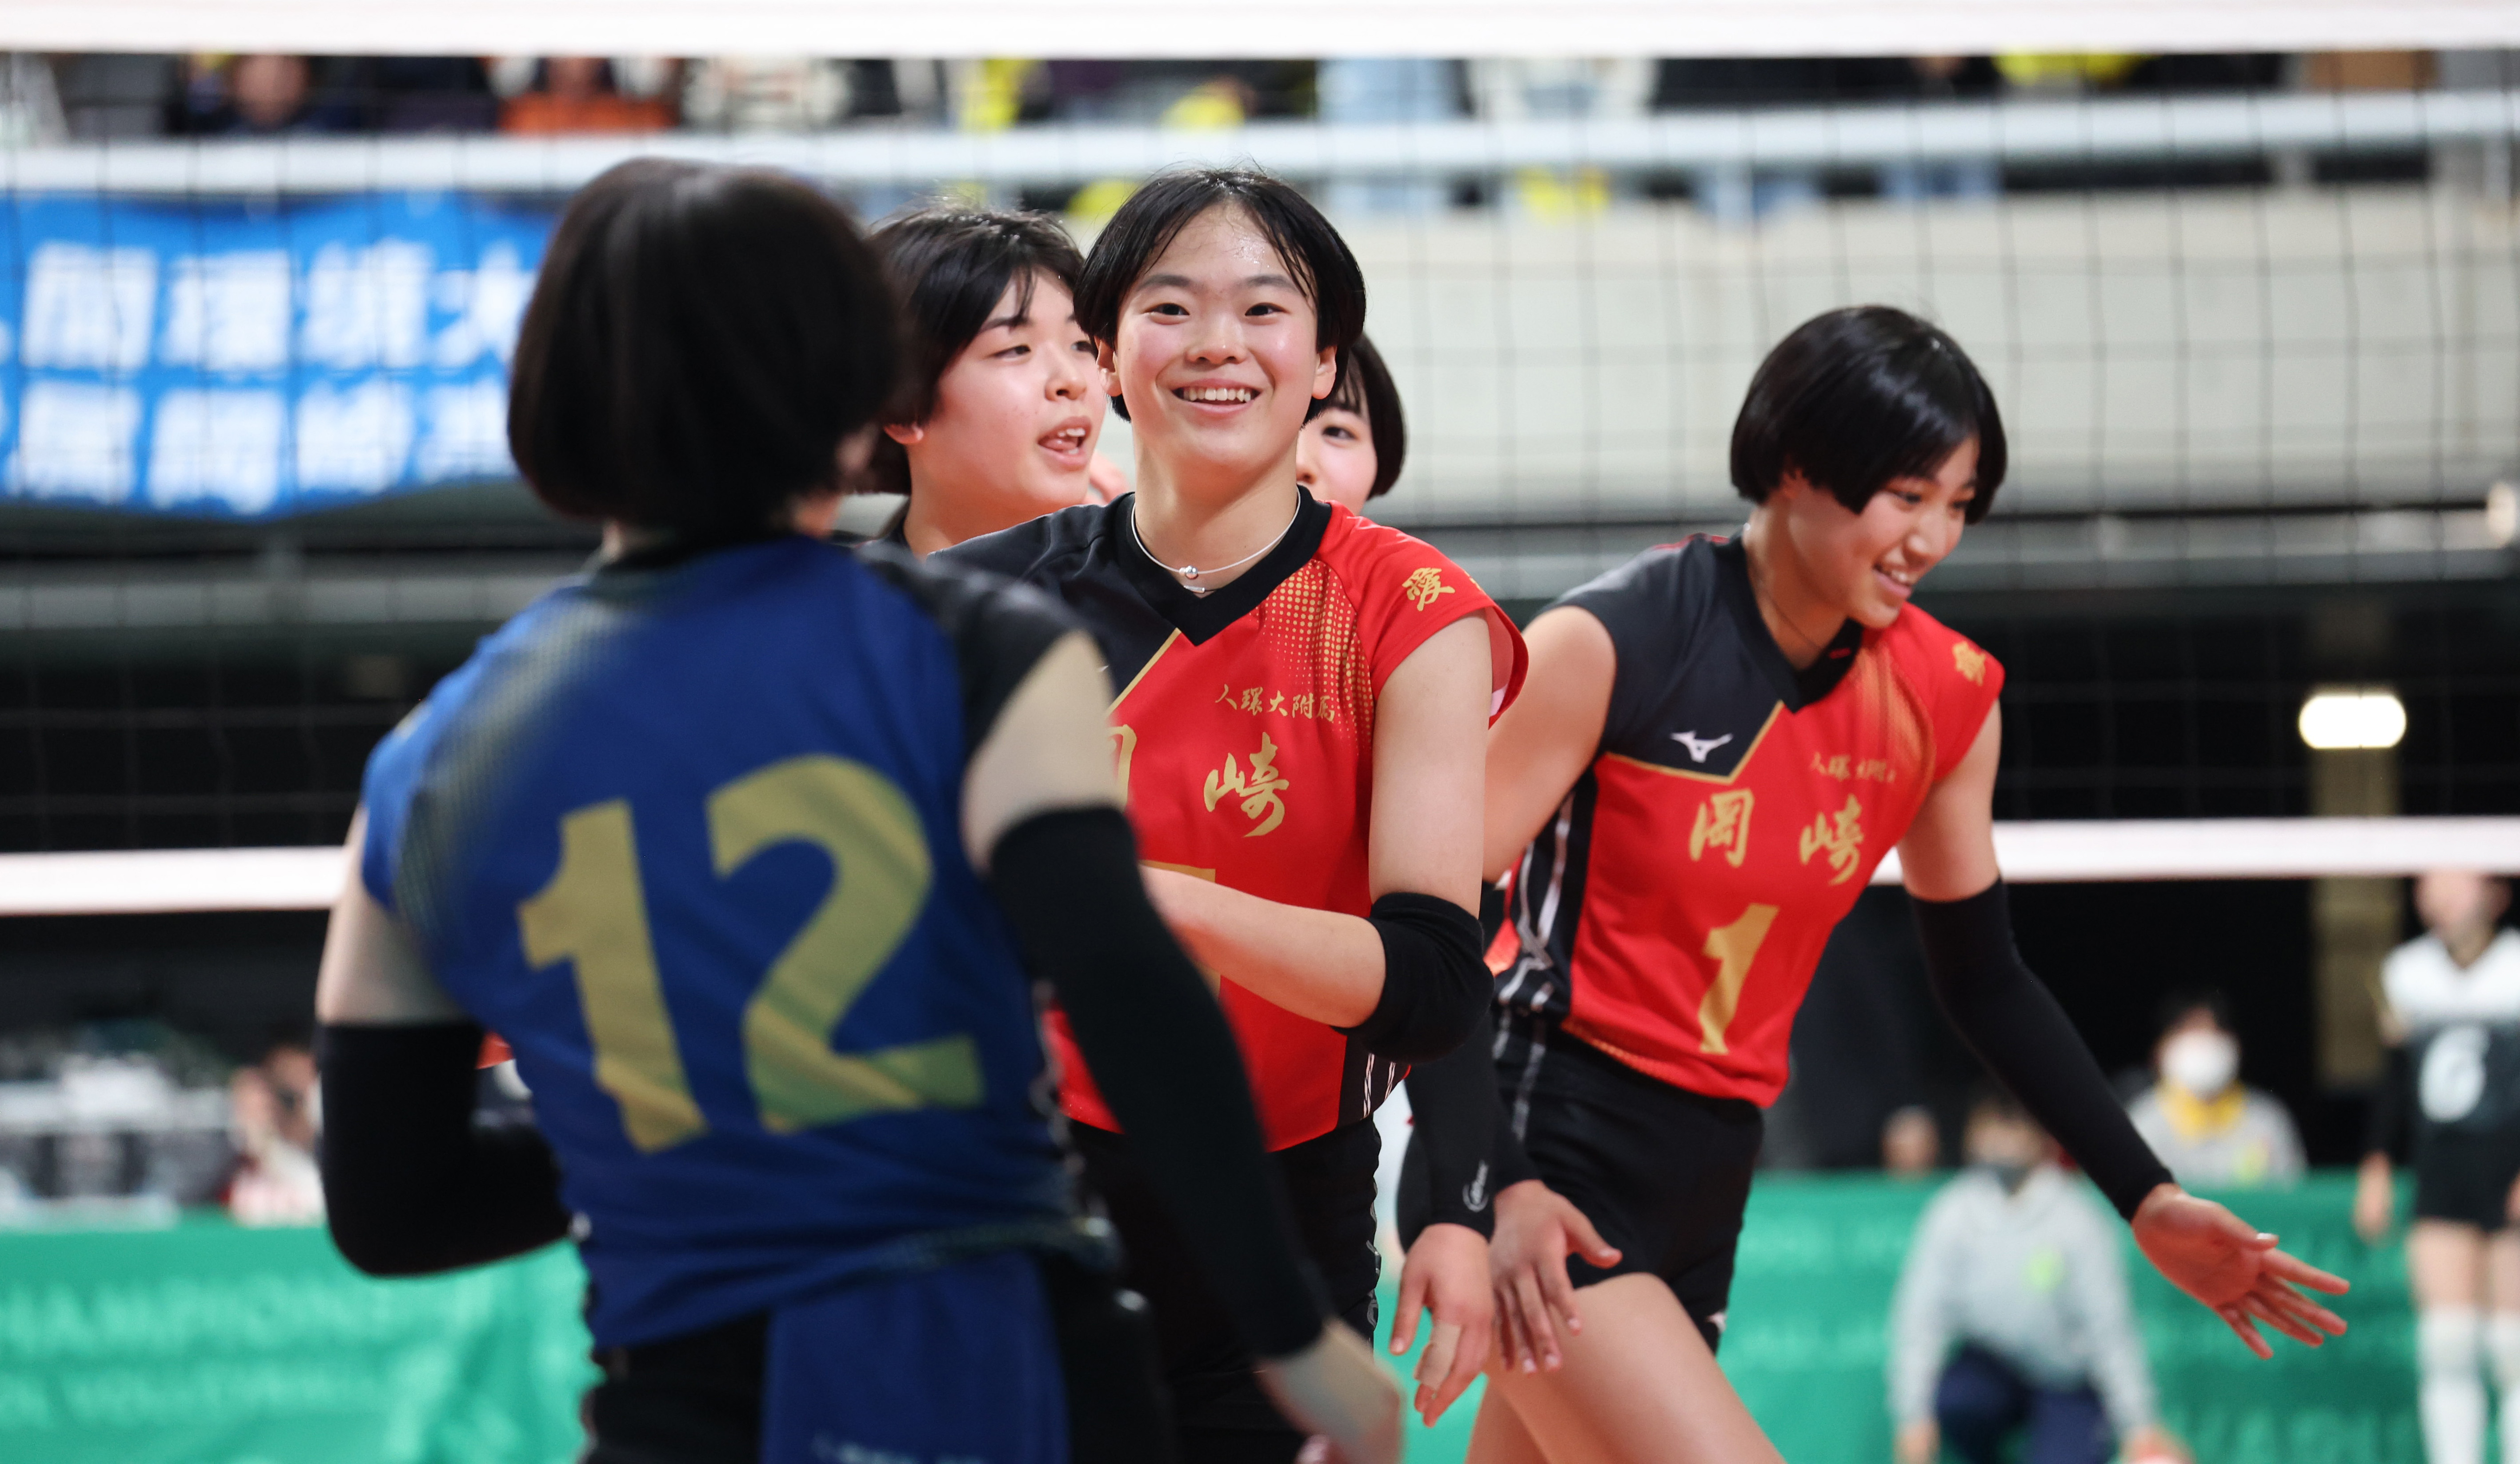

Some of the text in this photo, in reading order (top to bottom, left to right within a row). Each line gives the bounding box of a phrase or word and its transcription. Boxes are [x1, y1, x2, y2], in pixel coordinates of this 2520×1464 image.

[1402, 567, 1483, 612] 愛
[517, 753, 985, 1155] 12
[1698, 902, 1779, 1055] 1
